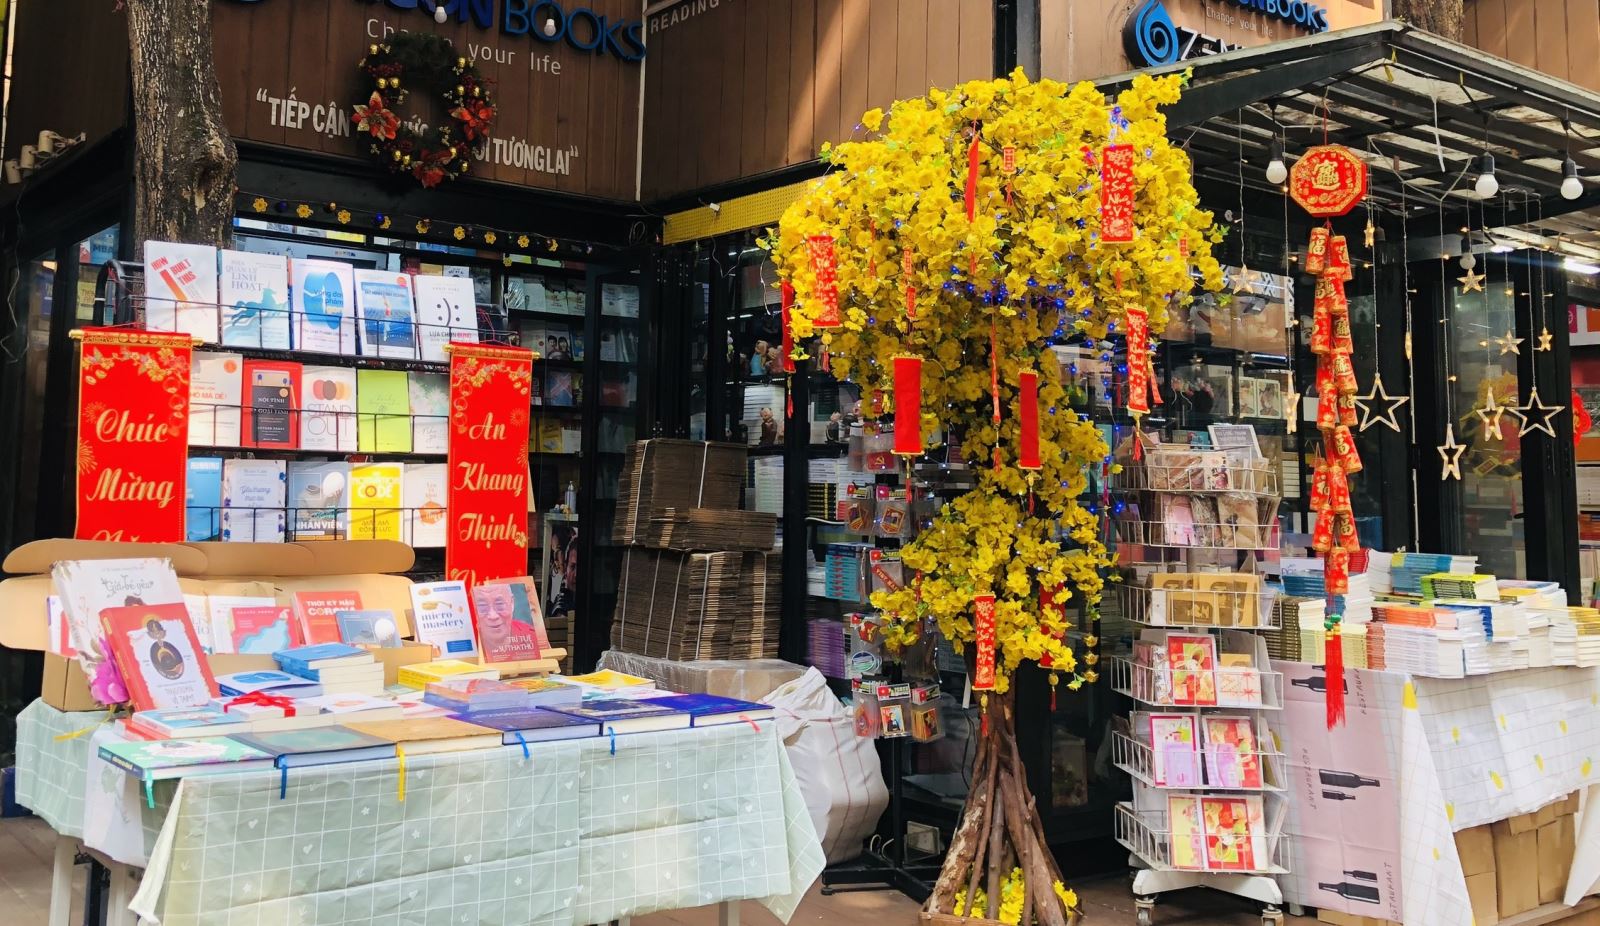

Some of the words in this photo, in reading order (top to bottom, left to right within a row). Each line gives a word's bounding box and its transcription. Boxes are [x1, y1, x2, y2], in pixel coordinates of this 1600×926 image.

[503, 0, 646, 62] BOOKS
[650, 0, 719, 35] READING
[1206, 6, 1235, 25] Change
[1240, 20, 1257, 31] your
[468, 43, 516, 66] your
[530, 52, 562, 75] life
[492, 136, 545, 172] TƯƠNG
[96, 408, 168, 443] Chúc
[307, 403, 354, 418] STAND
[468, 412, 507, 441] An
[86, 467, 176, 509] Mừng
[453, 461, 524, 497] Khang
[458, 512, 518, 549] Thịnh
[422, 618, 464, 630] mastery
